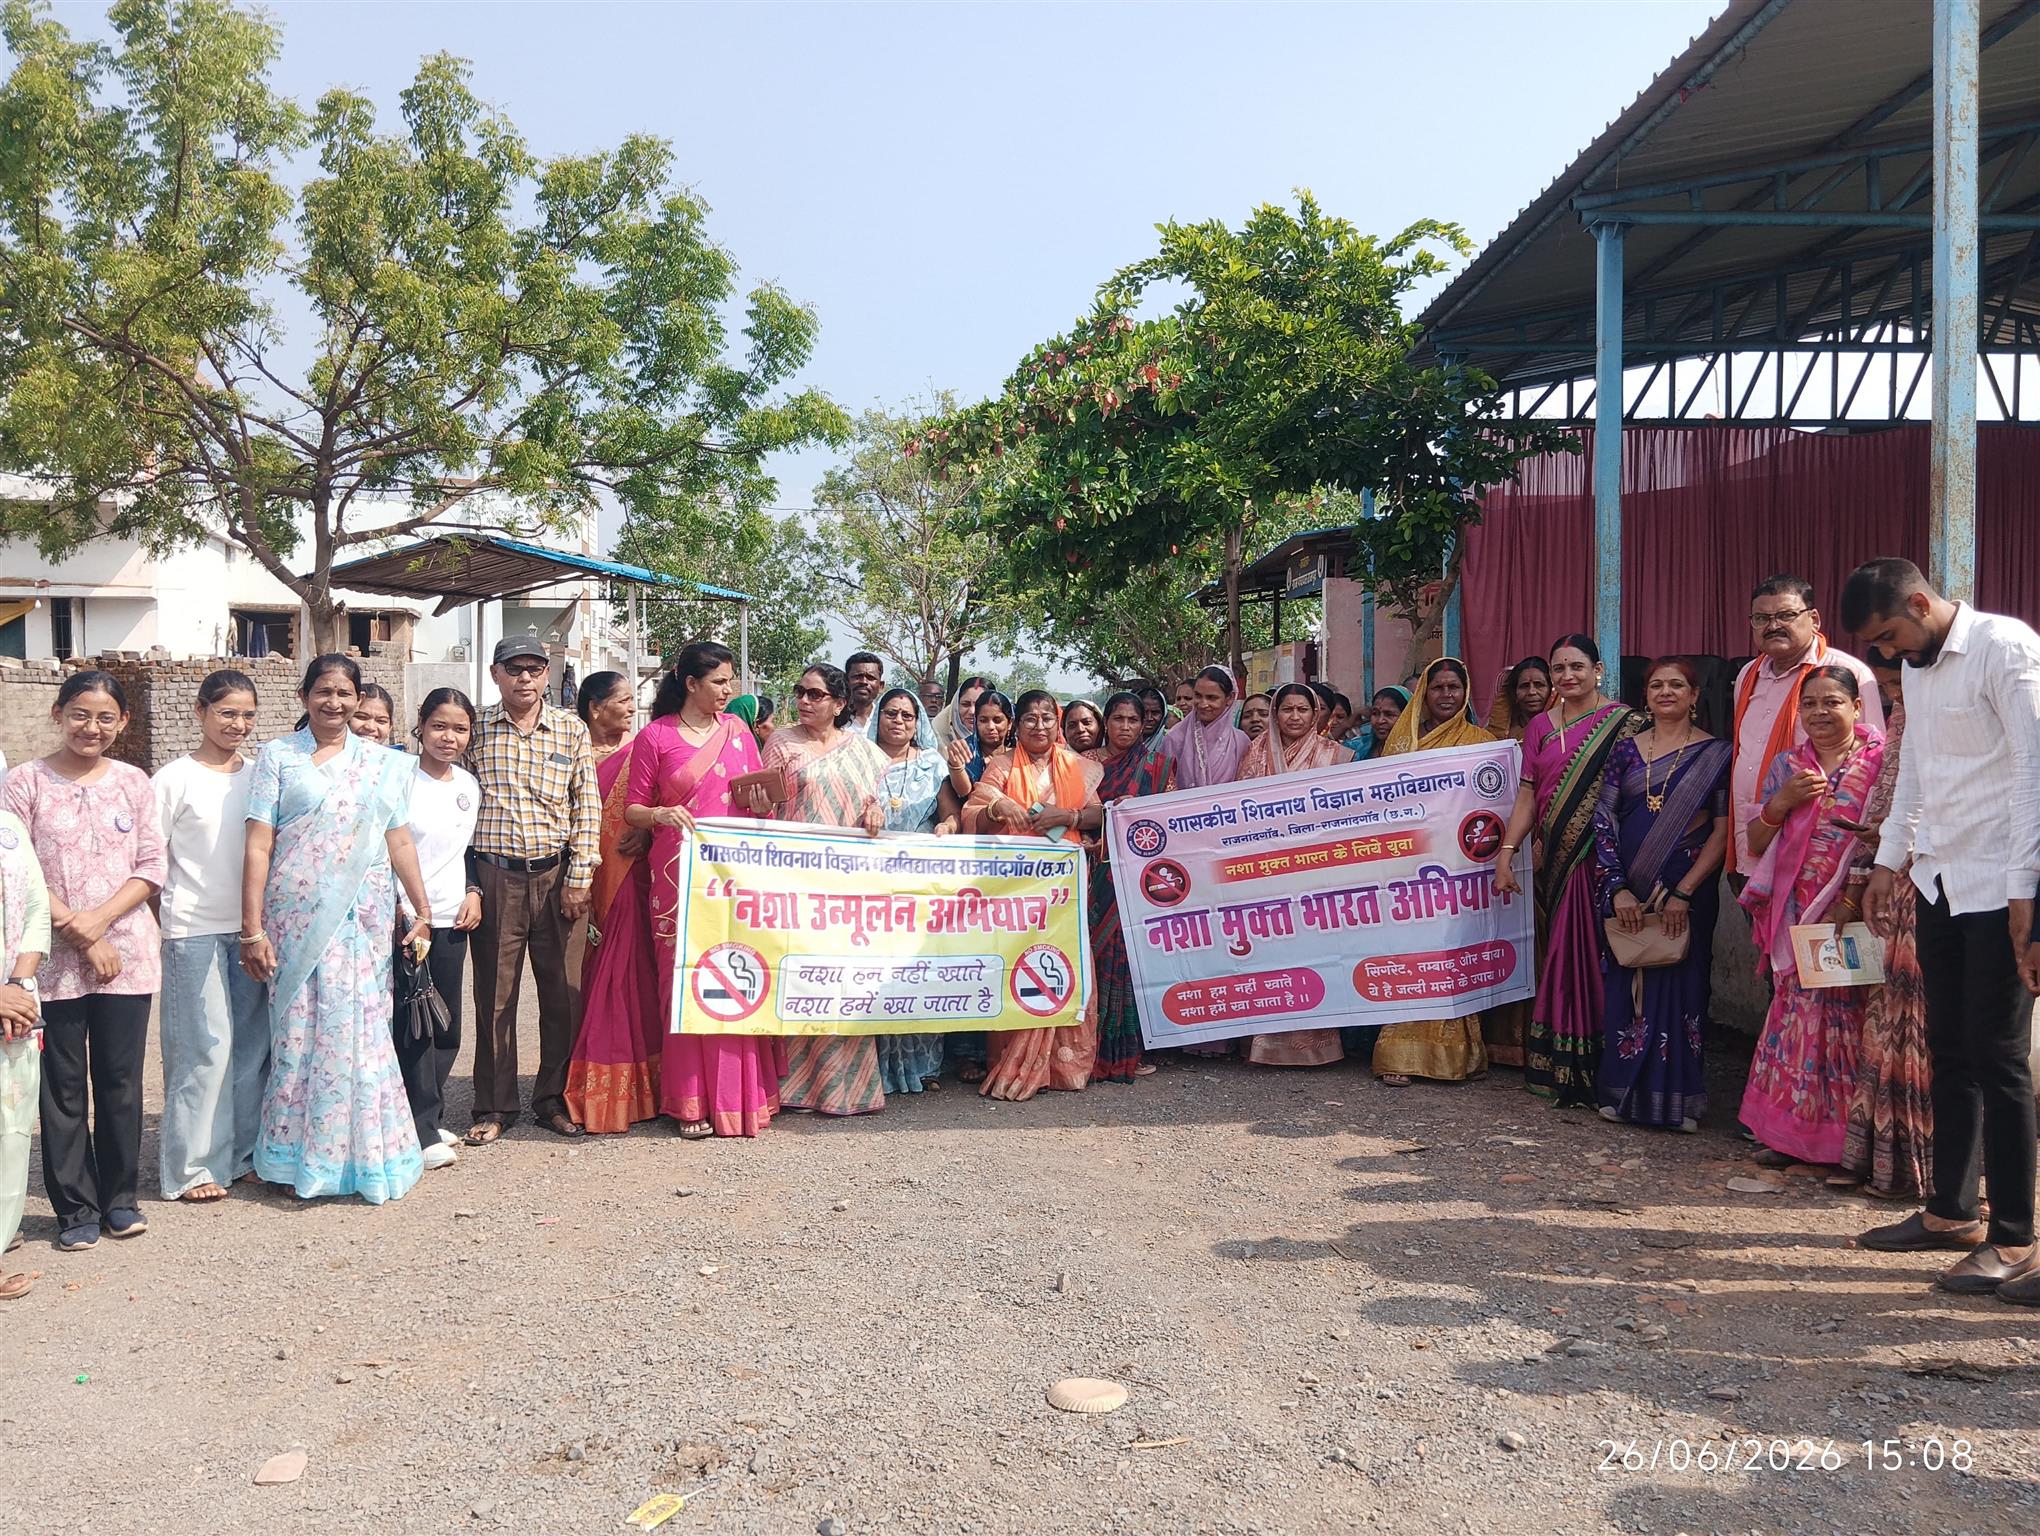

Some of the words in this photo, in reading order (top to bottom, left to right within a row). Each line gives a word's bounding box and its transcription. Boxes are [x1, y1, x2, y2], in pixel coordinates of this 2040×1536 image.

[1168, 804, 1237, 833] शासकीय
[1240, 796, 1305, 823] शिवनाथ
[1310, 787, 1364, 811] विज्ञान
[1368, 772, 1466, 803] महाविद्यालय
[700, 841, 763, 866] शासकीय
[766, 841, 822, 870] शिवनाथ
[826, 846, 869, 874] विज्ञान
[958, 854, 1036, 878] राजनांदगाँव
[1225, 861, 1254, 876] नशा
[1258, 856, 1290, 875] मुक्त
[1295, 850, 1329, 865] भारत
[1332, 843, 1348, 859] के
[1352, 838, 1382, 857] लिये
[1386, 837, 1413, 856] युवा
[808, 893, 916, 946] उन्मूलन
[1144, 909, 1212, 952] नशा
[1217, 898, 1294, 956] मुक्त
[1300, 885, 1381, 930] भारत
[1033, 944, 1061, 955] SMOKING
[799, 965, 845, 985] नशा
[891, 960, 932, 984] नहीं
[937, 958, 986, 982] खाते
[1417, 959, 1459, 973] तम्बाकू
[1177, 989, 1202, 1001] नशा
[1209, 985, 1228, 999] हम
[1264, 973, 1293, 990] खाते
[1368, 983, 1379, 997] ये
[1396, 979, 1426, 995] जल्दी
[1430, 976, 1455, 993] मरने
[1458, 973, 1469, 988] के
[1470, 970, 1494, 984] उपाय
[785, 996, 834, 1017] नशा
[840, 990, 879, 1016] हमें
[883, 996, 918, 1014] खा
[923, 994, 972, 1012] जाता
[977, 986, 994, 1012] है
[1180, 1005, 1205, 1017] नशा
[1230, 1000, 1250, 1012] खा
[1253, 996, 1281, 1008] जाता
[1284, 991, 1295, 1006] है
